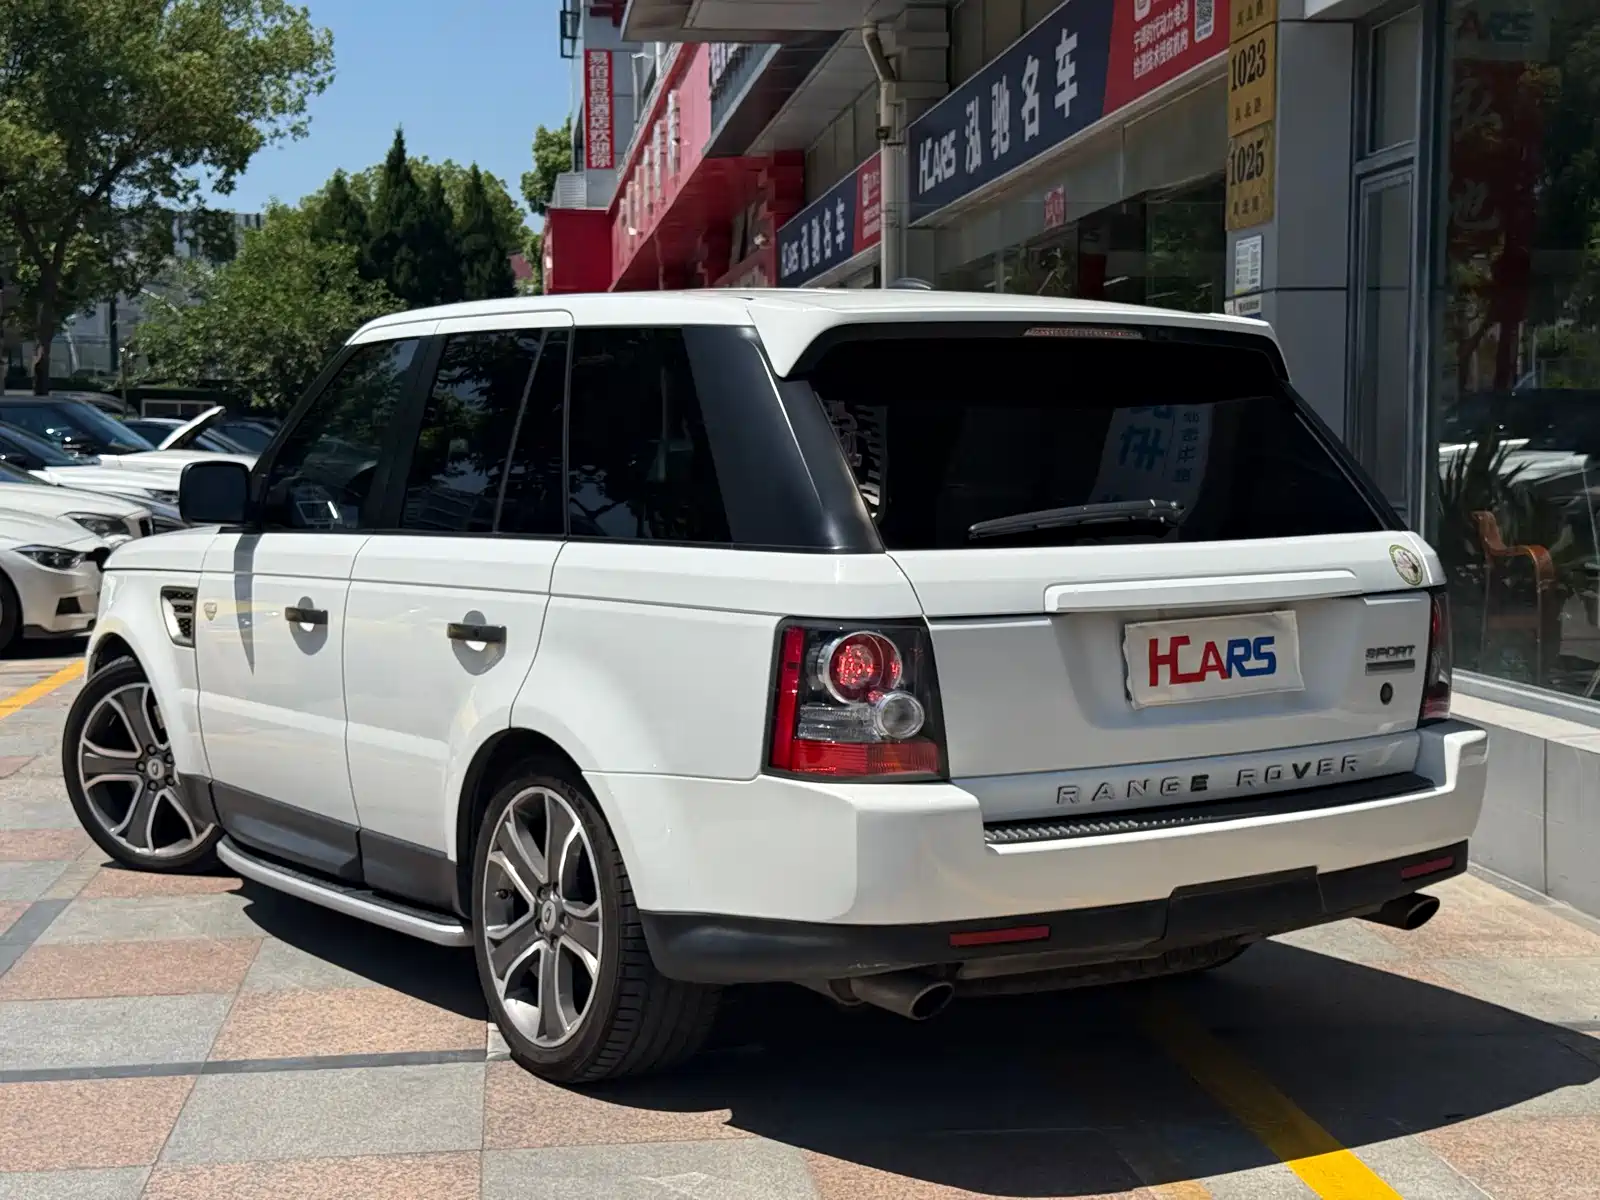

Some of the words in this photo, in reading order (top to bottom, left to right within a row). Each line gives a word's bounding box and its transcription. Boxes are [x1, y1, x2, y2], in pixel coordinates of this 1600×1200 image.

[1231, 38, 1266, 91] 1023
[919, 129, 956, 195] HCARS
[965, 28, 1078, 175] 泓驰名车
[1230, 139, 1264, 186] 1025
[1149, 636, 1277, 687] HCARS
[1365, 645, 1416, 660] SPORT
[1056, 774, 1210, 805] RANGE
[1236, 755, 1361, 788] ROVER
